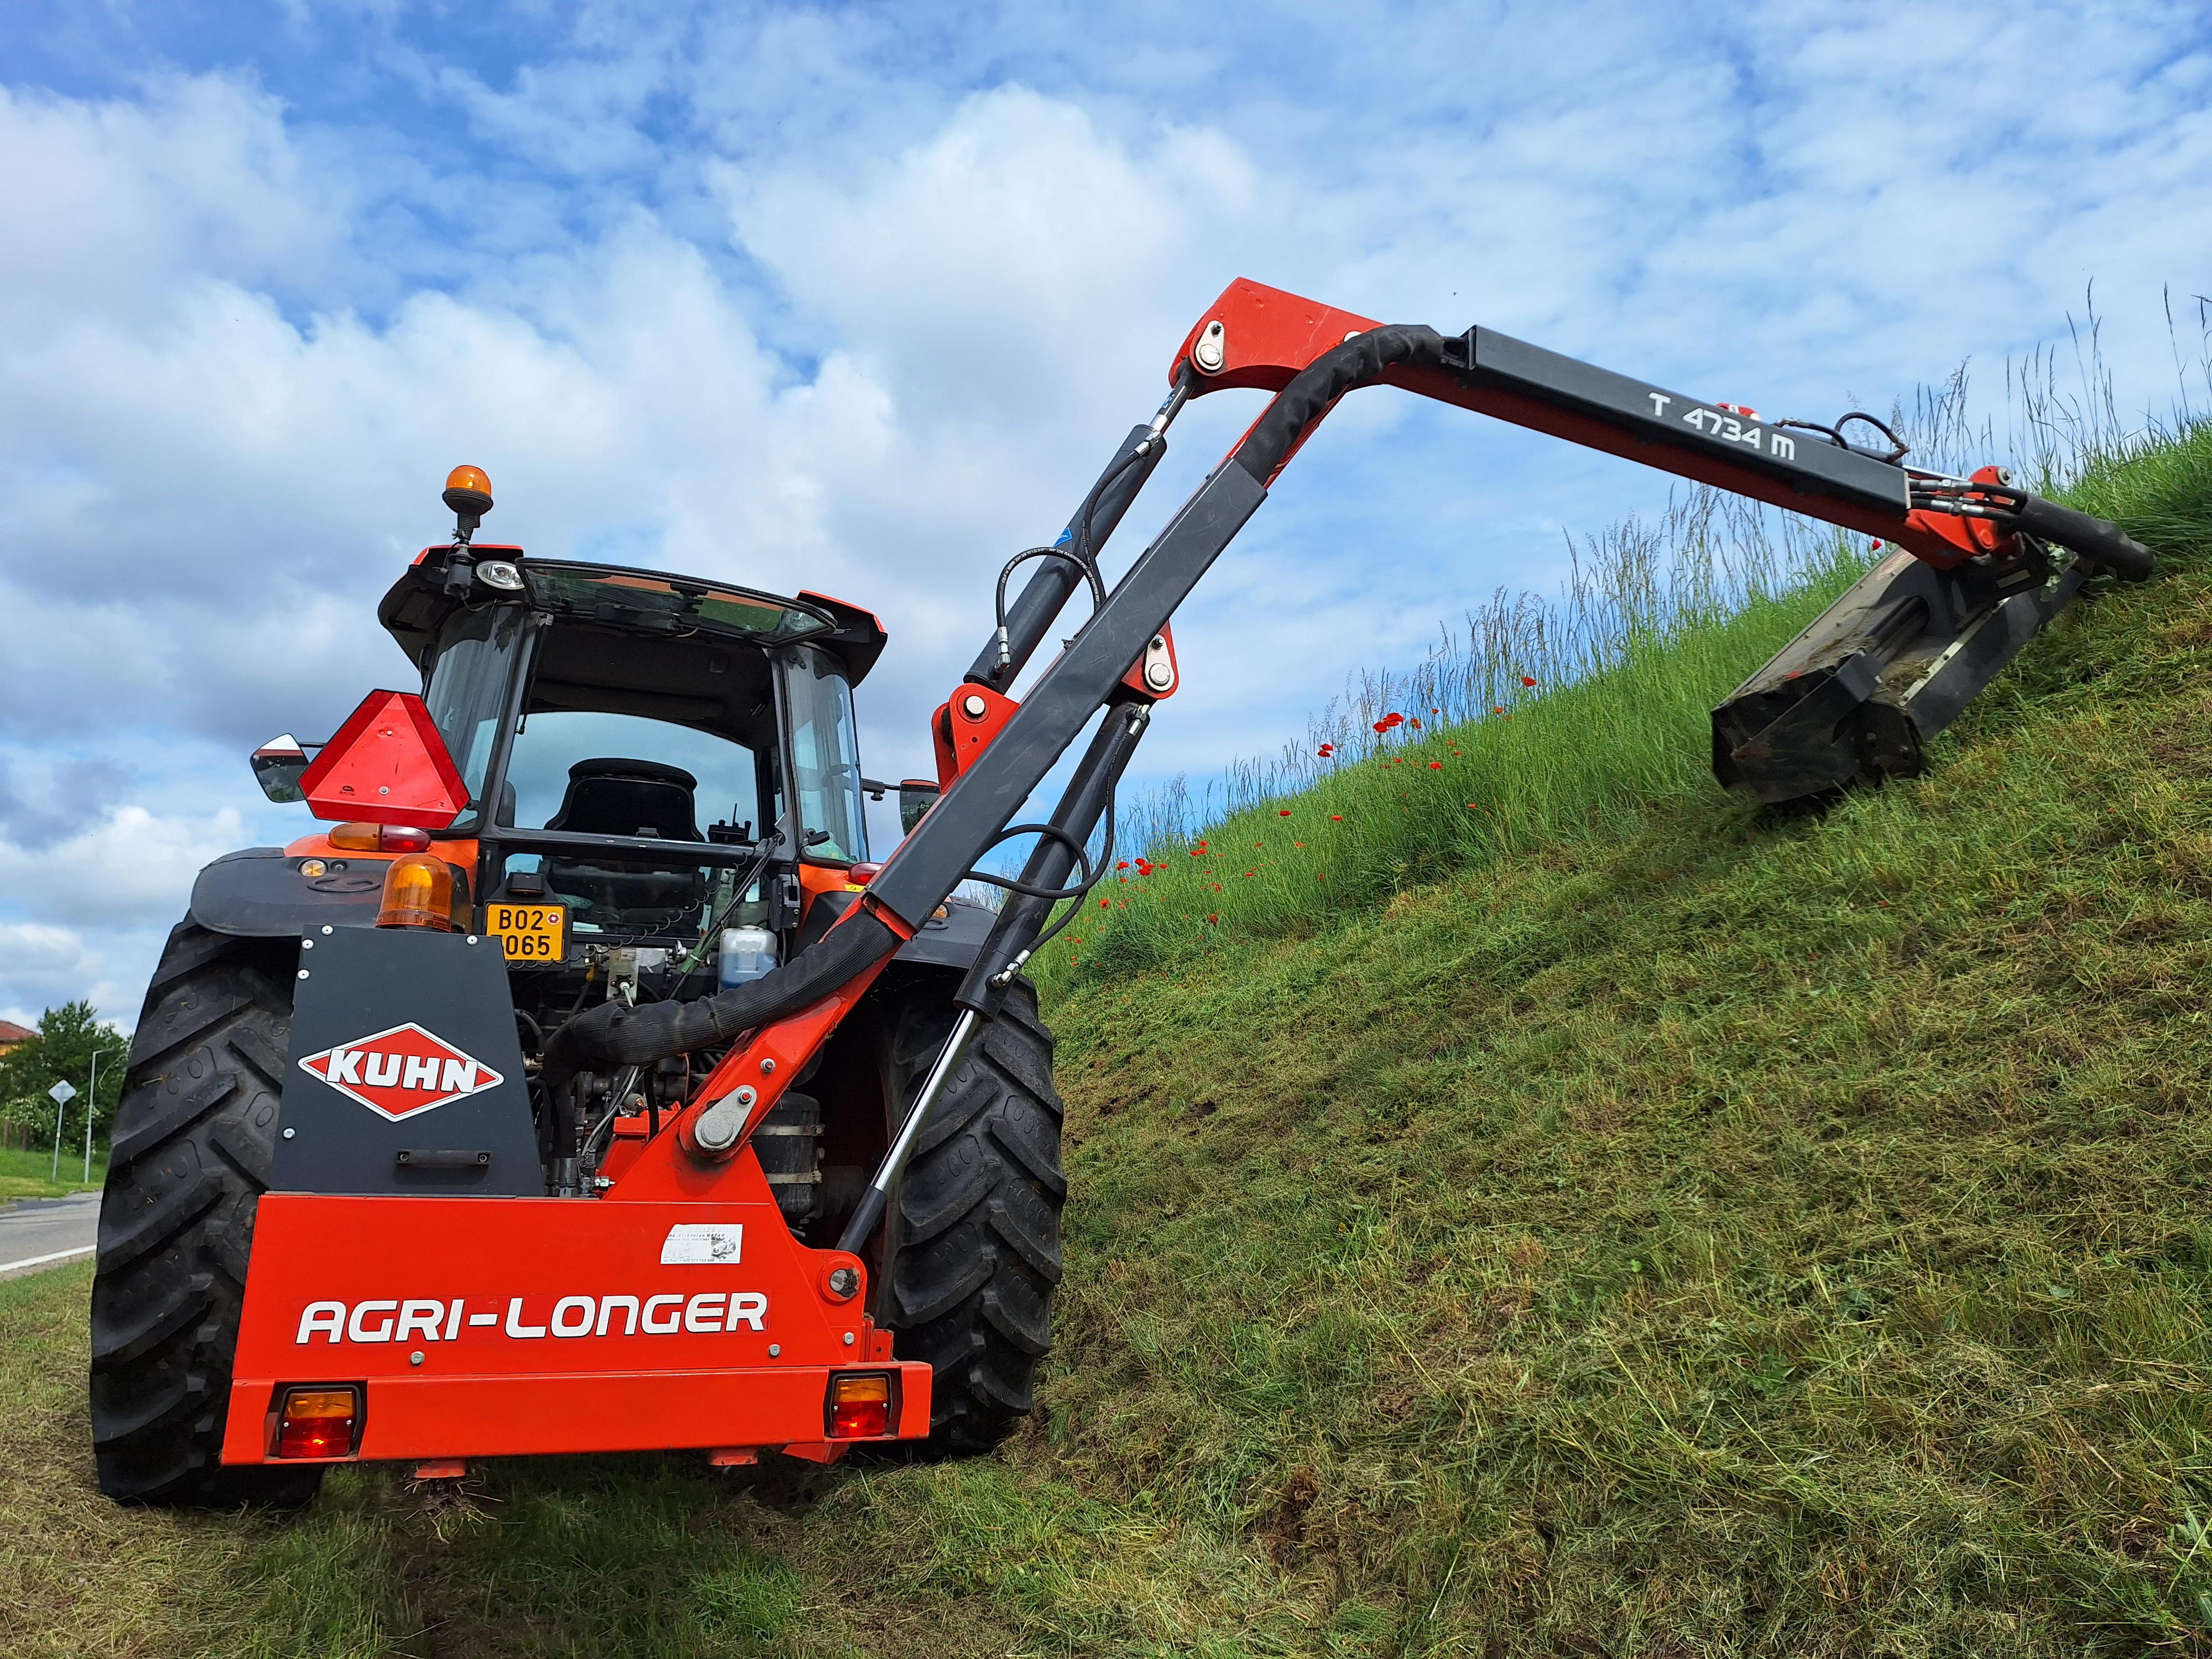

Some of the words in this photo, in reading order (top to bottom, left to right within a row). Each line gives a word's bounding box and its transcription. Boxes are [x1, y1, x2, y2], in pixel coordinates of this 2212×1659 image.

[1648, 392, 1671, 416] T
[1682, 408, 1761, 449] 4734
[499, 909, 544, 930] B02
[491, 934, 550, 956] 065
[326, 1049, 478, 1093] KUHN
[295, 1292, 769, 1344] AGRI-LONGER
